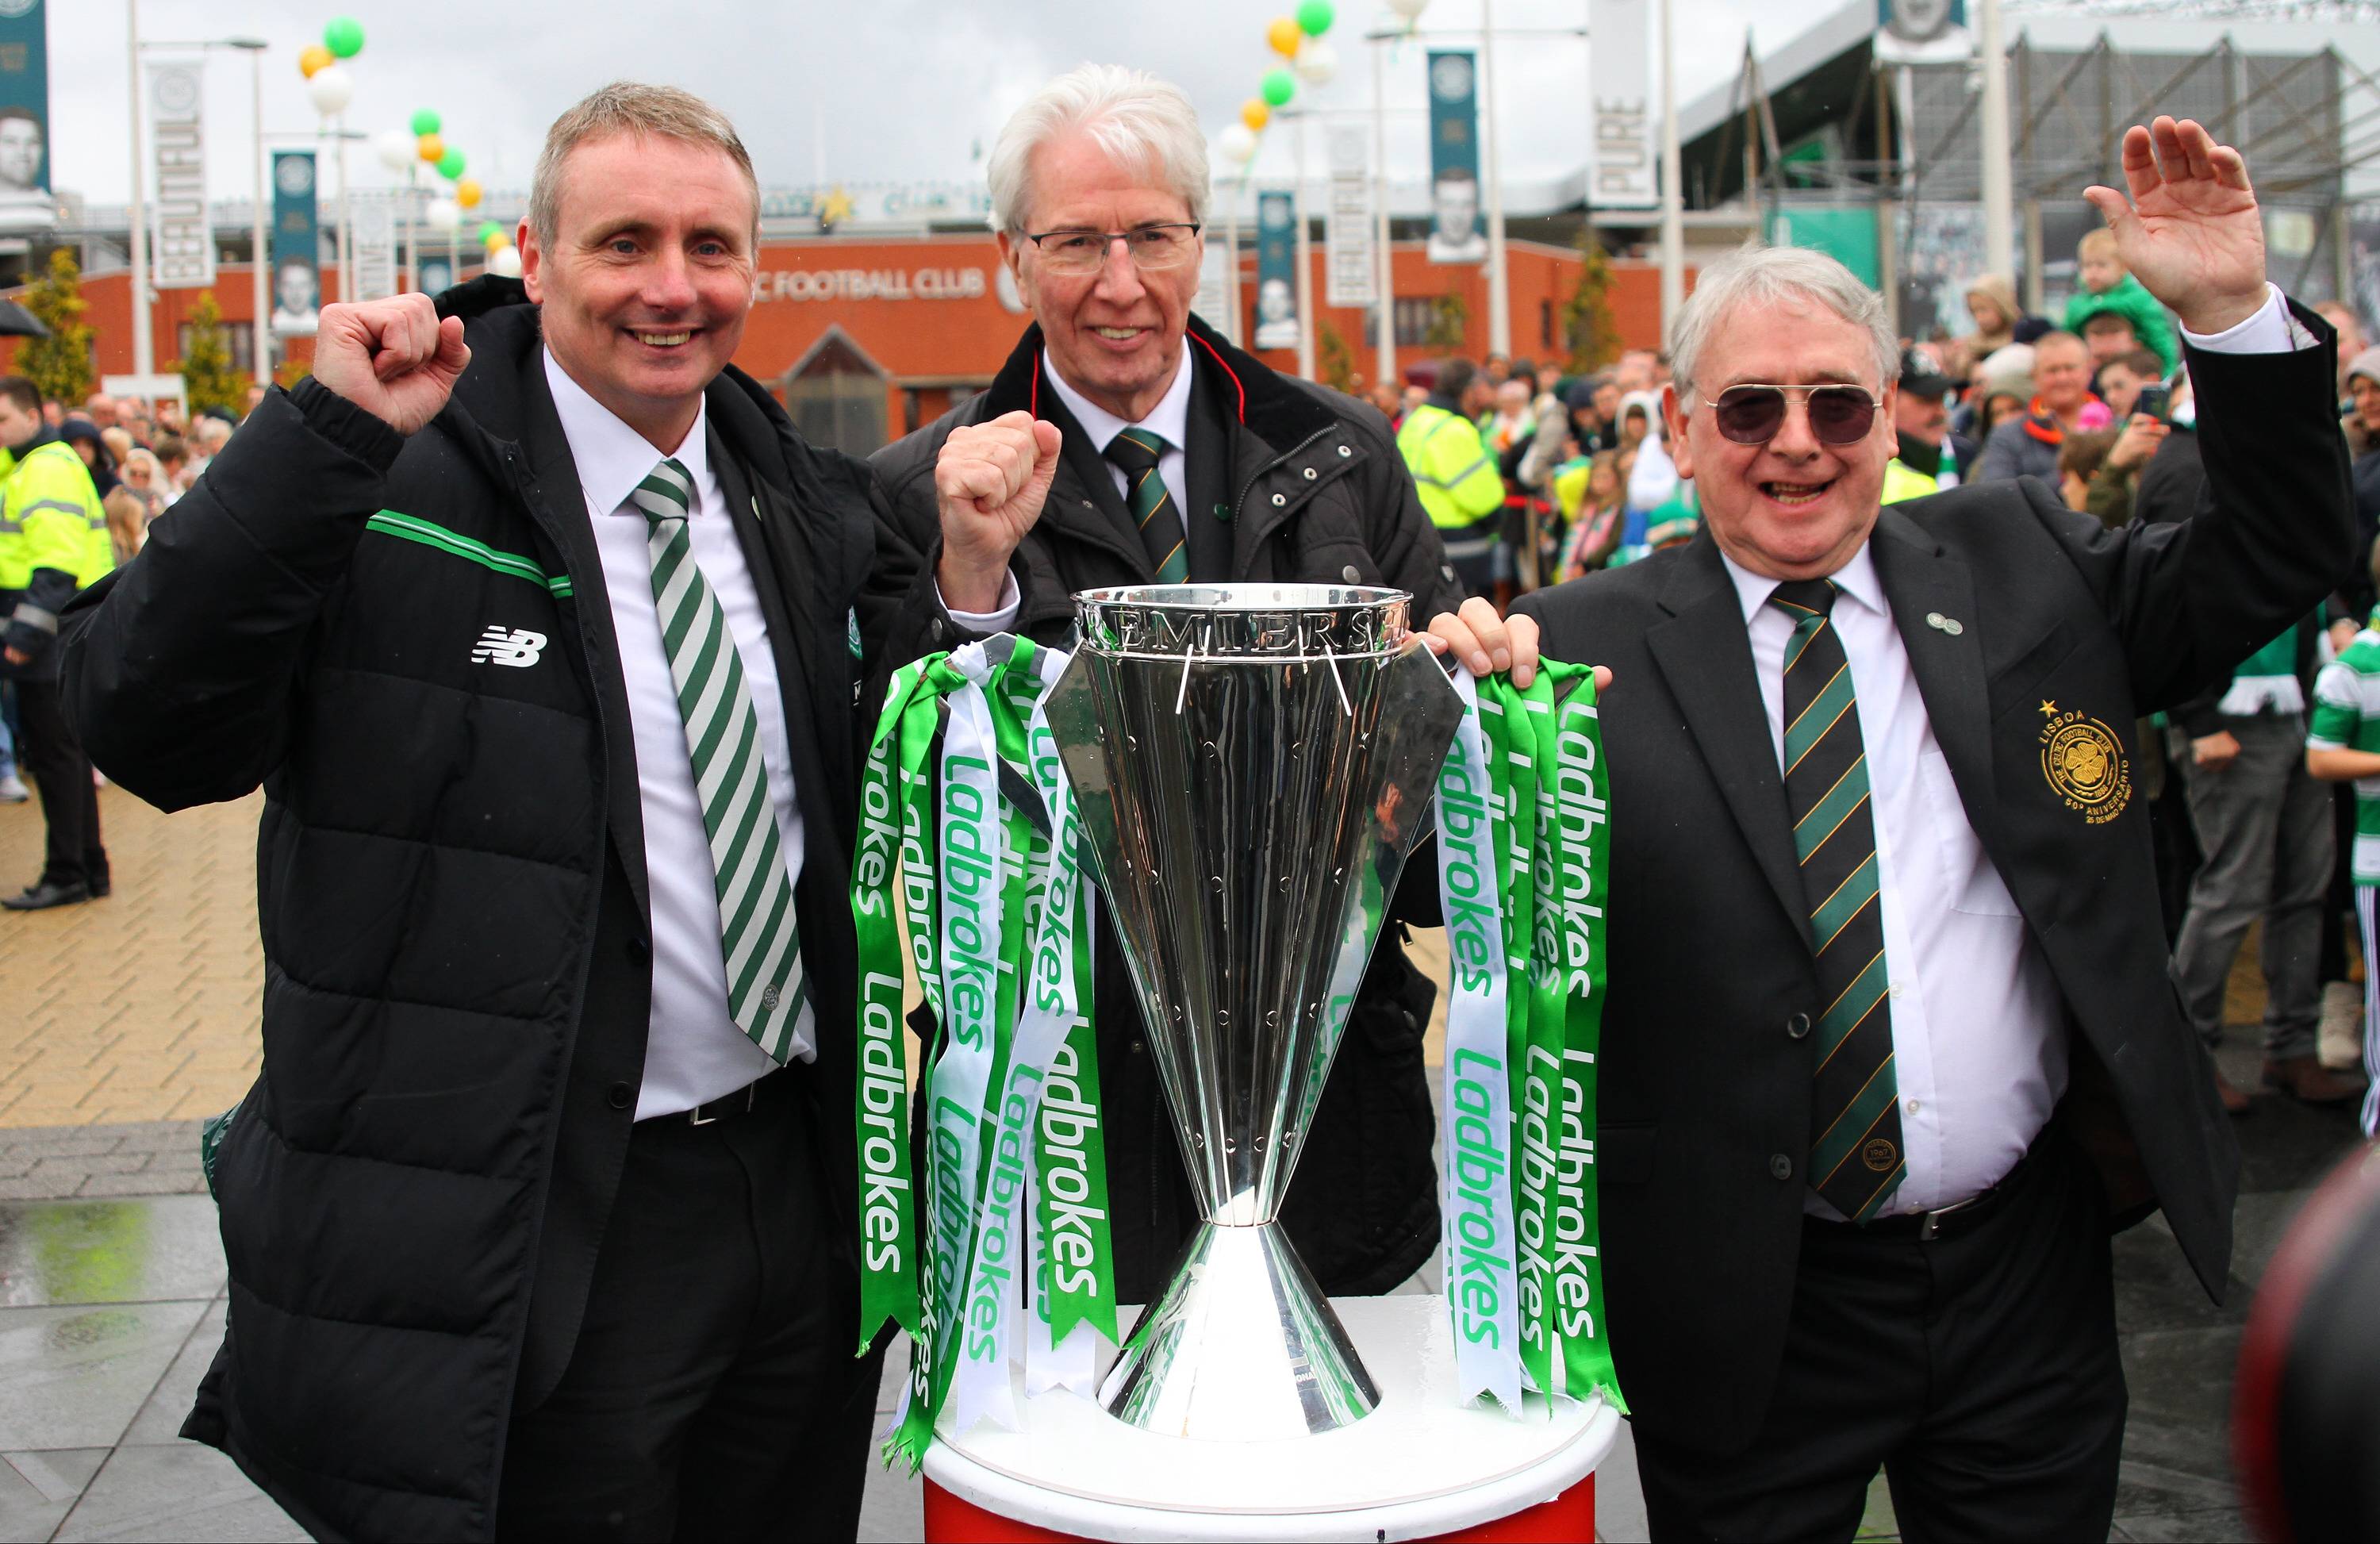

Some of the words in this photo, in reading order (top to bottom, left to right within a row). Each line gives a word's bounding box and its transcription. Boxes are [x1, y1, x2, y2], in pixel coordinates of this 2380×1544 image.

[1596, 97, 1647, 193] PURE
[155, 113, 205, 278] BEAUTIFUL
[773, 269, 912, 302] FOOTBALL
[913, 267, 985, 300] CLUB
[471, 625, 547, 667] NB
[2038, 709, 2085, 744] LISBOA
[2054, 742, 2063, 766] CELTIC
[2060, 728, 2094, 743] FOOTBALL
[2096, 735, 2111, 753] CLUB
[2056, 768, 2067, 782] THE
[2096, 816, 2106, 824] DE
[1439, 705, 1495, 997] adbrokes
[945, 755, 996, 1054] Ladbrokes
[862, 970, 909, 1273] Ladbrokes
[935, 1096, 977, 1333] Ladbrok
[968, 1062, 1043, 1363] Ladbrokes
[1453, 1047, 1511, 1350] Ladbrokes
[1519, 1044, 1559, 1352] Ladbrokes
